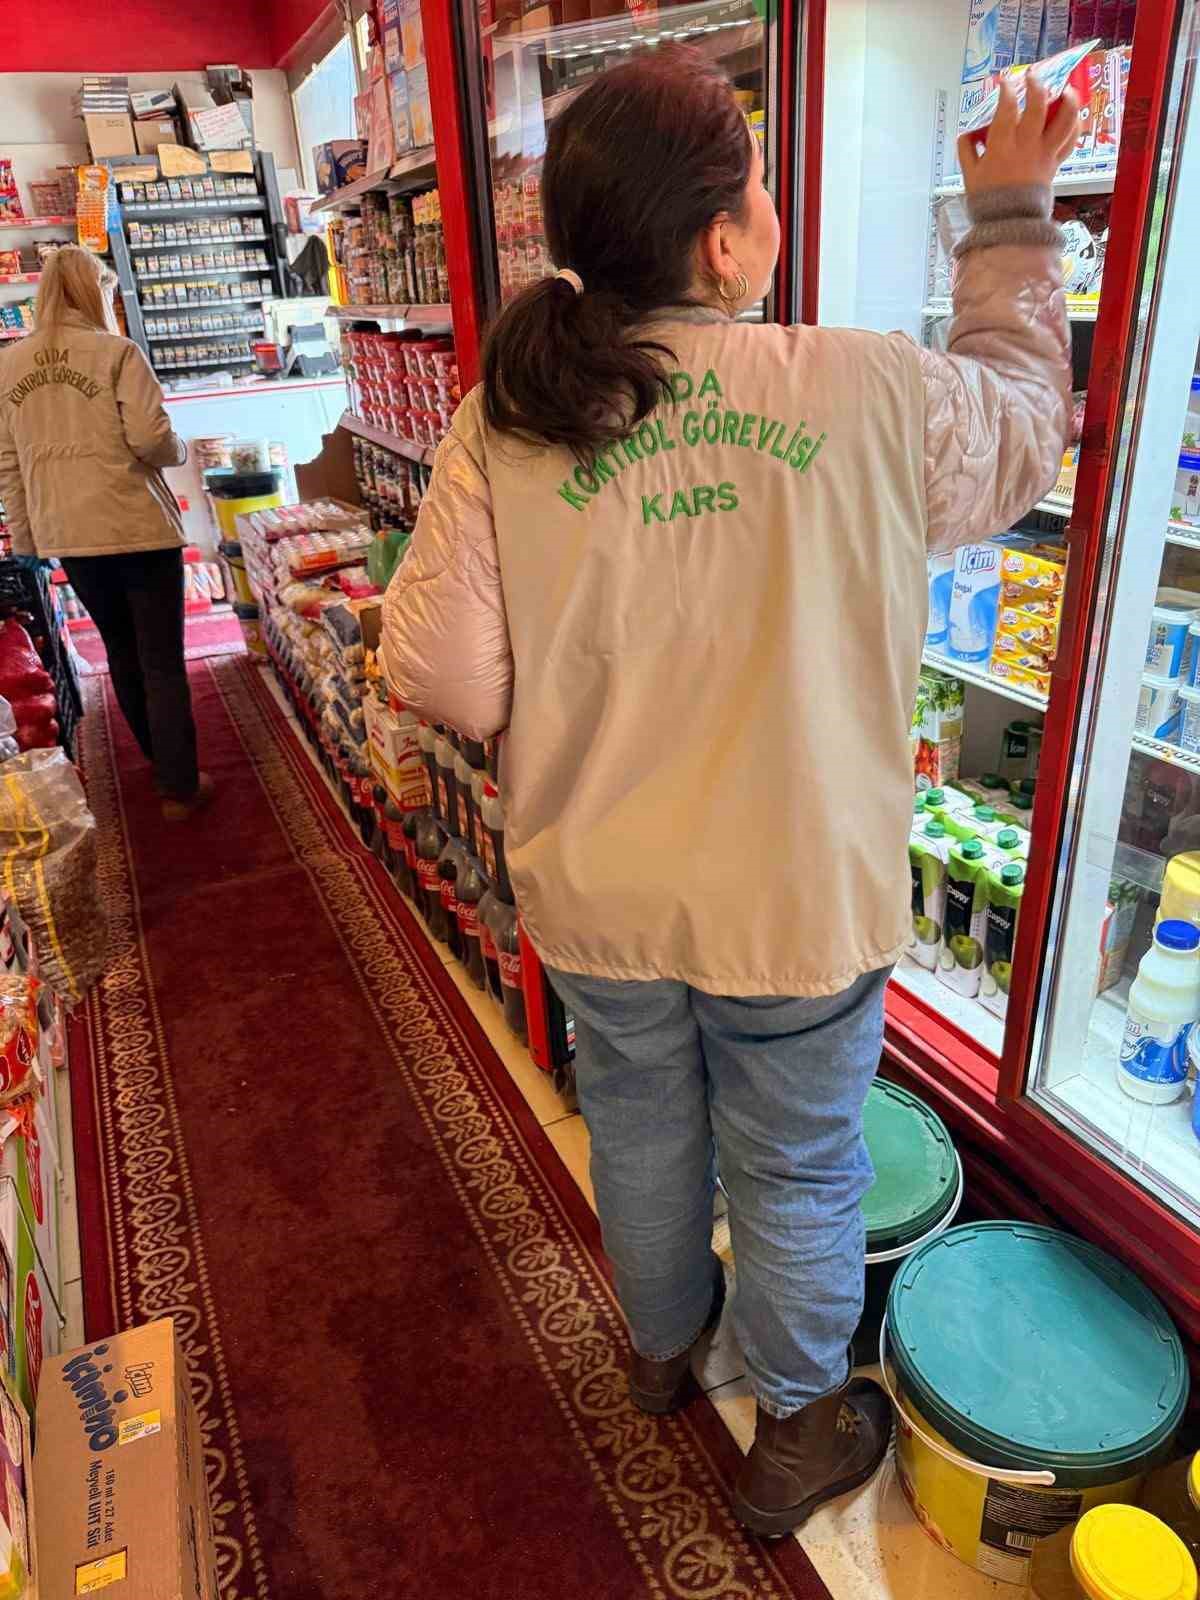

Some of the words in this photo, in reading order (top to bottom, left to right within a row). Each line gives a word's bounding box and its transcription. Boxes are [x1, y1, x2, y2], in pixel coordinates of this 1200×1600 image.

[682, 401, 827, 474] GÖREVLİSİ
[641, 482, 739, 525] KARS
[87, 1502, 102, 1526] UHT
